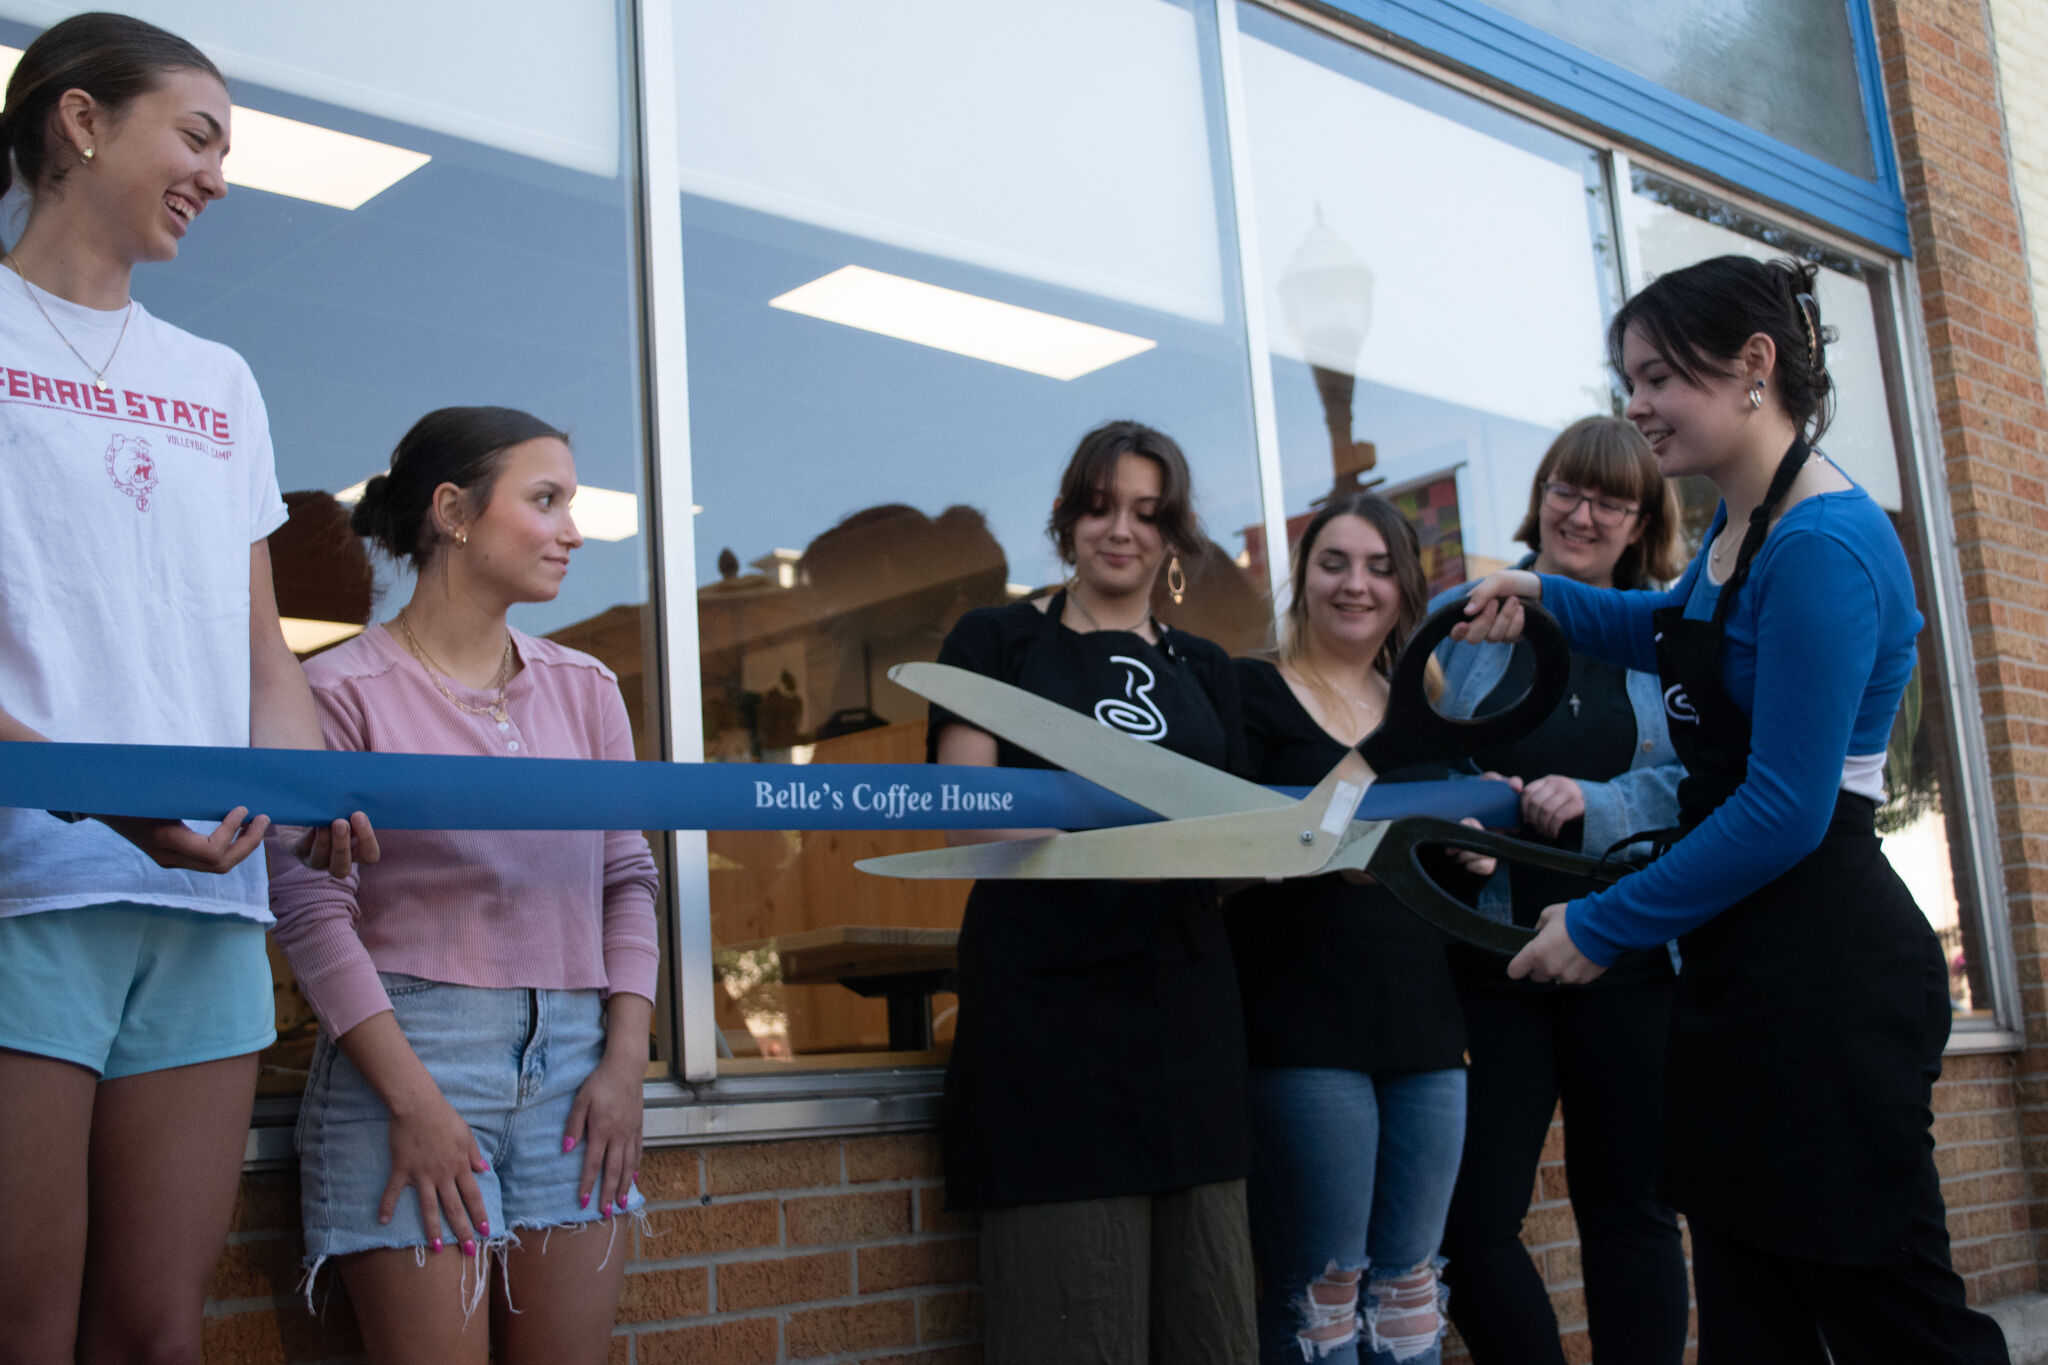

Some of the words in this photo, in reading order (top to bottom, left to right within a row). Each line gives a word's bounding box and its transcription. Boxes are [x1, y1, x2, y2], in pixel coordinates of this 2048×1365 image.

[0, 366, 117, 414] ERRIS
[122, 390, 230, 439] STATE
[166, 434, 210, 455] VOLLEYBALL
[211, 448, 232, 461] CAMP
[754, 781, 844, 810] Belle's
[852, 783, 933, 818] Coffee
[940, 784, 1013, 811] House
